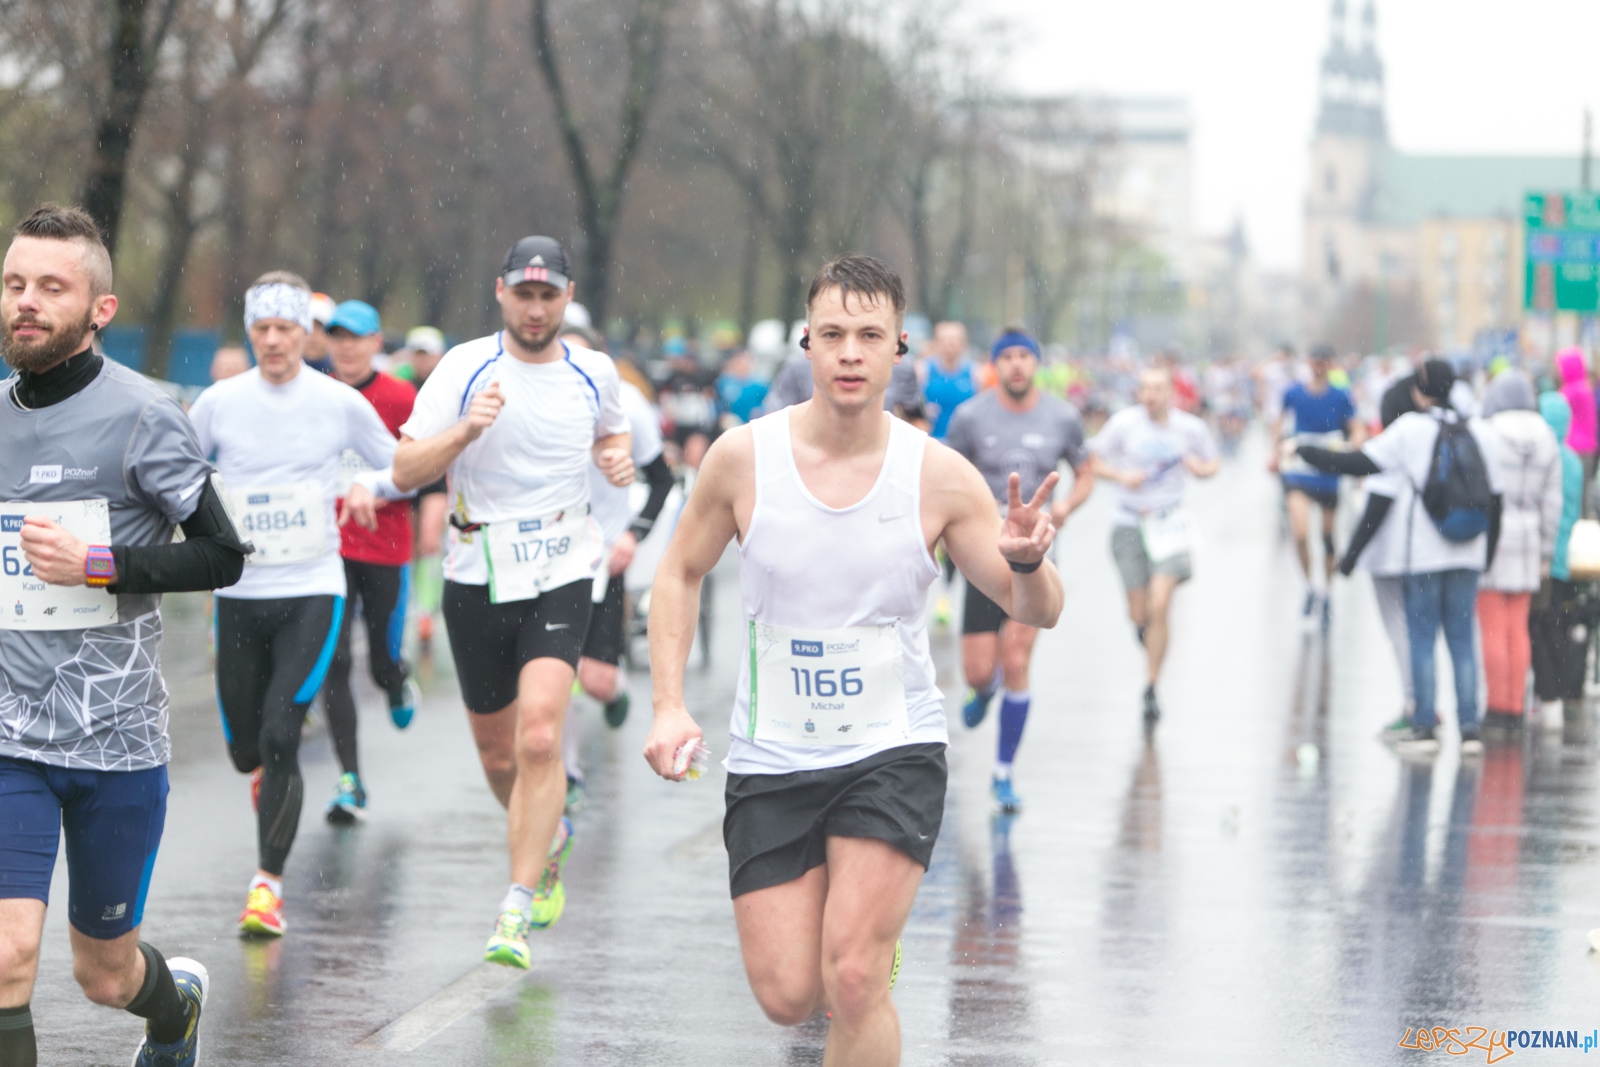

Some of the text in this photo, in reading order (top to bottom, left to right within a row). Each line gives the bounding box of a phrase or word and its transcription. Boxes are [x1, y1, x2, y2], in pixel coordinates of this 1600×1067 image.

[22, 582, 46, 591] Karol
[794, 644, 820, 654] 9.PKO
[790, 667, 863, 697] 1166
[811, 702, 844, 711] Michał
